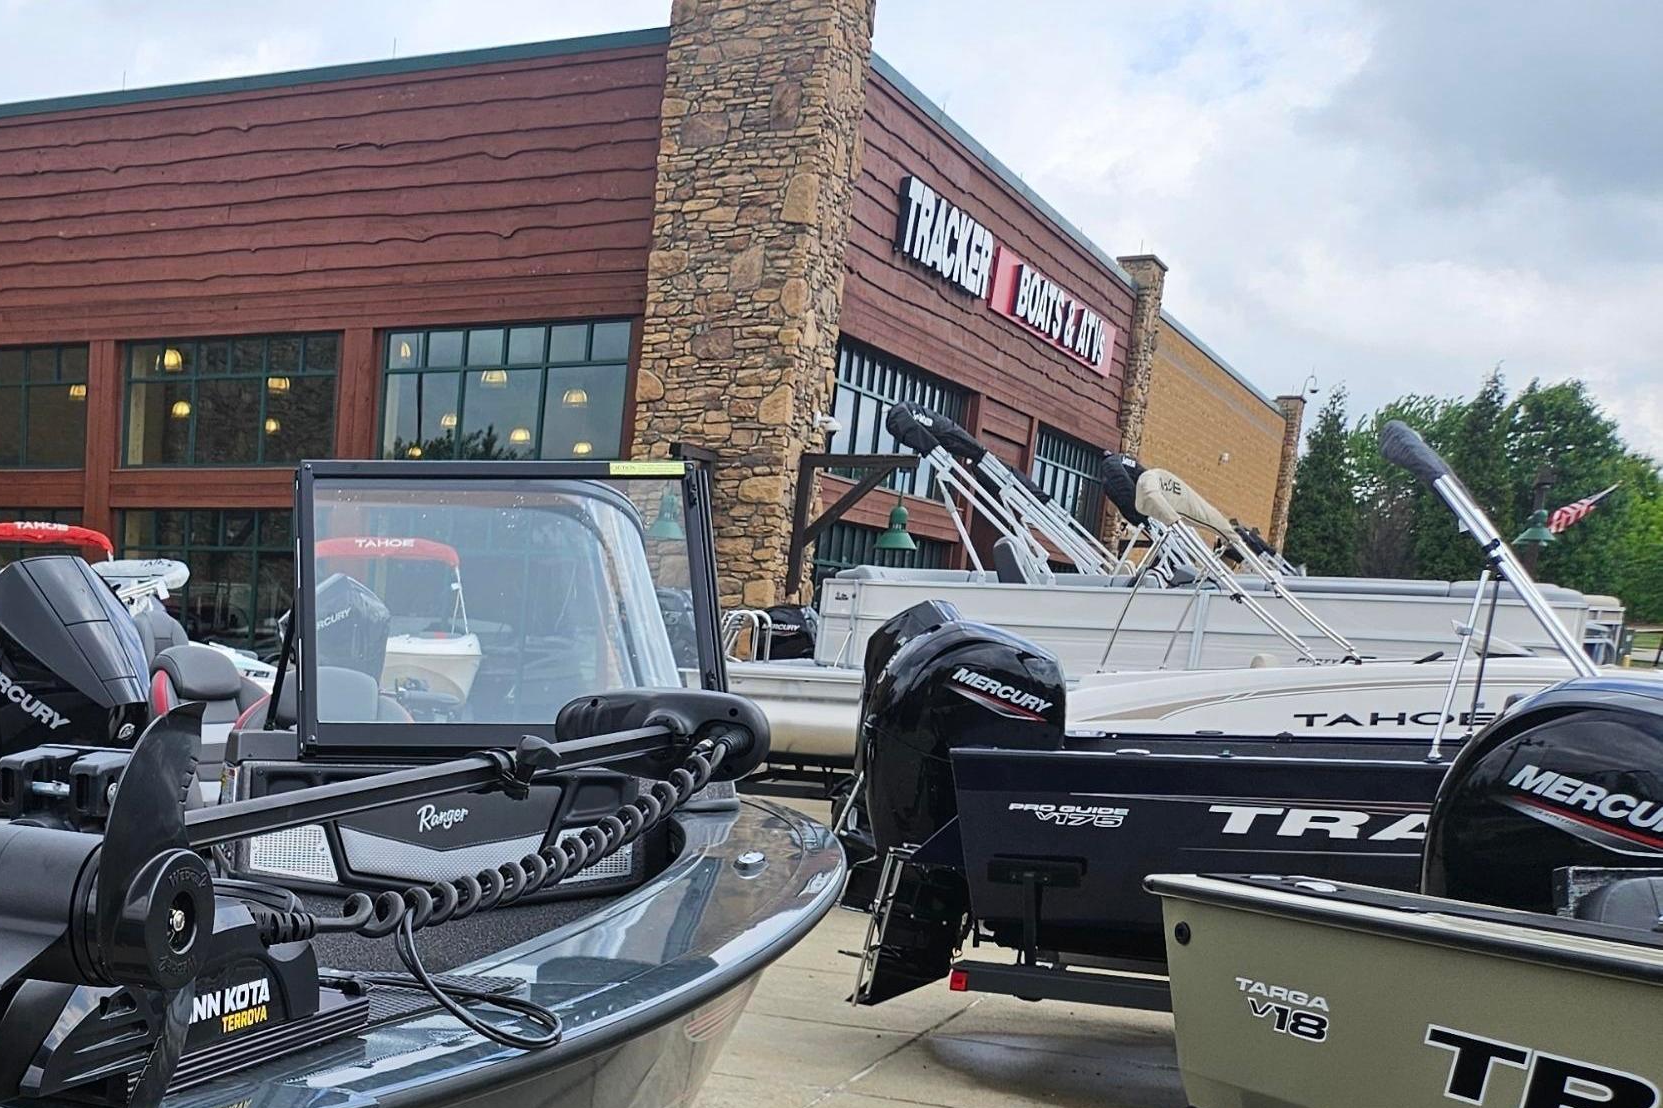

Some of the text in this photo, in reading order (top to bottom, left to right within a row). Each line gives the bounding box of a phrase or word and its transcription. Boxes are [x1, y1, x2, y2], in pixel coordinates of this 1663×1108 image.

[903, 176, 1106, 367] TRACKER BOATS & ATVs
[14, 521, 69, 532] TAHOE
[354, 537, 415, 548] TAHOE
[951, 667, 1054, 714] MERCURY
[1293, 711, 1497, 728] TAHOE
[416, 804, 469, 833] Ranger
[1008, 802, 1130, 816] PRO GUIDE
[1035, 811, 1125, 828] V175
[224, 978, 270, 1015] KOTA
[1235, 976, 1330, 1012] TARGA
[221, 1005, 268, 1034] TERROVA
[1247, 997, 1329, 1043] V18
